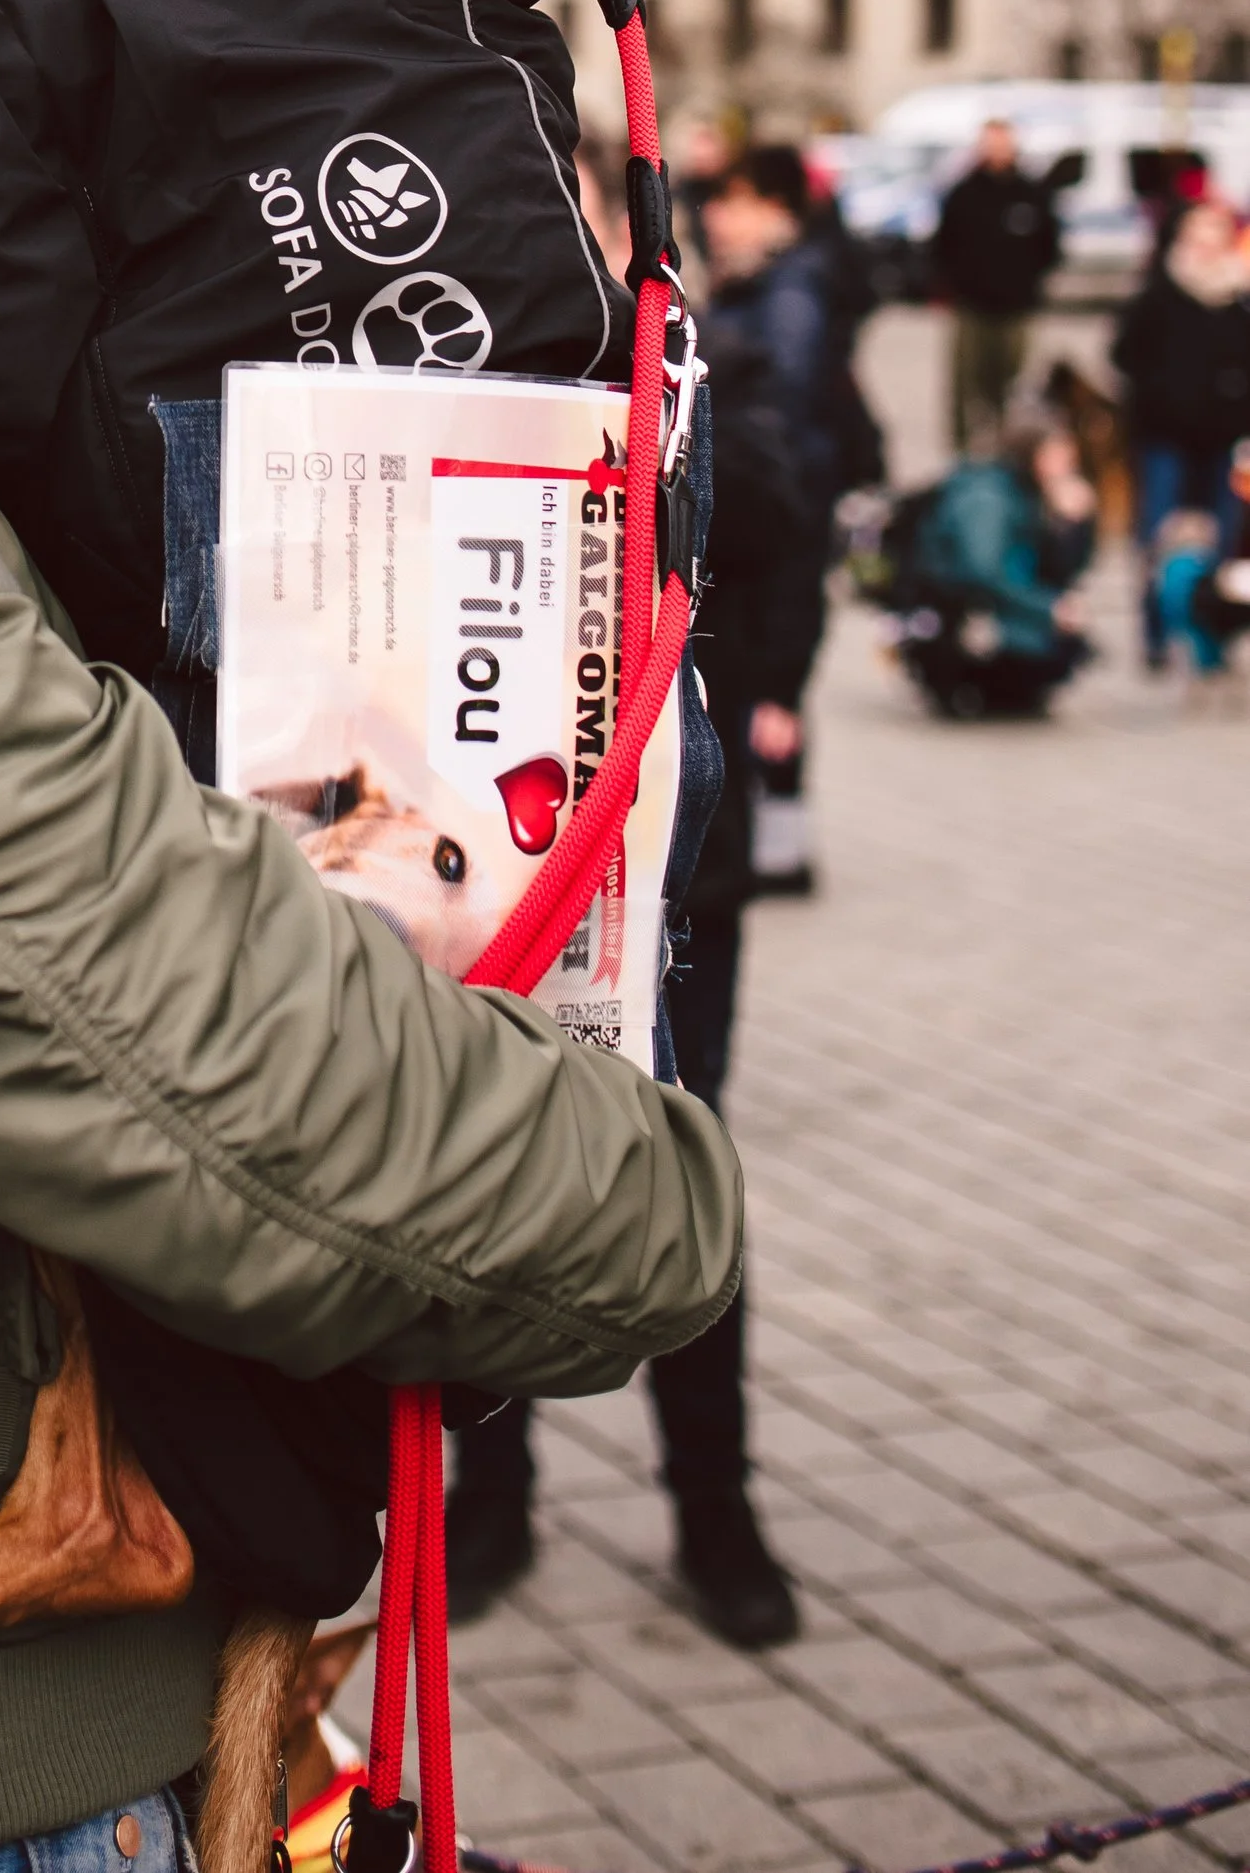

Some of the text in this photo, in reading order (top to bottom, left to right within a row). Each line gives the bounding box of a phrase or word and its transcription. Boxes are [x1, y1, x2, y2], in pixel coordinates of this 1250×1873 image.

[249, 168, 340, 374] SOFA DO
[454, 536, 525, 742] Filou
[539, 484, 558, 608] Ich bin dabei
